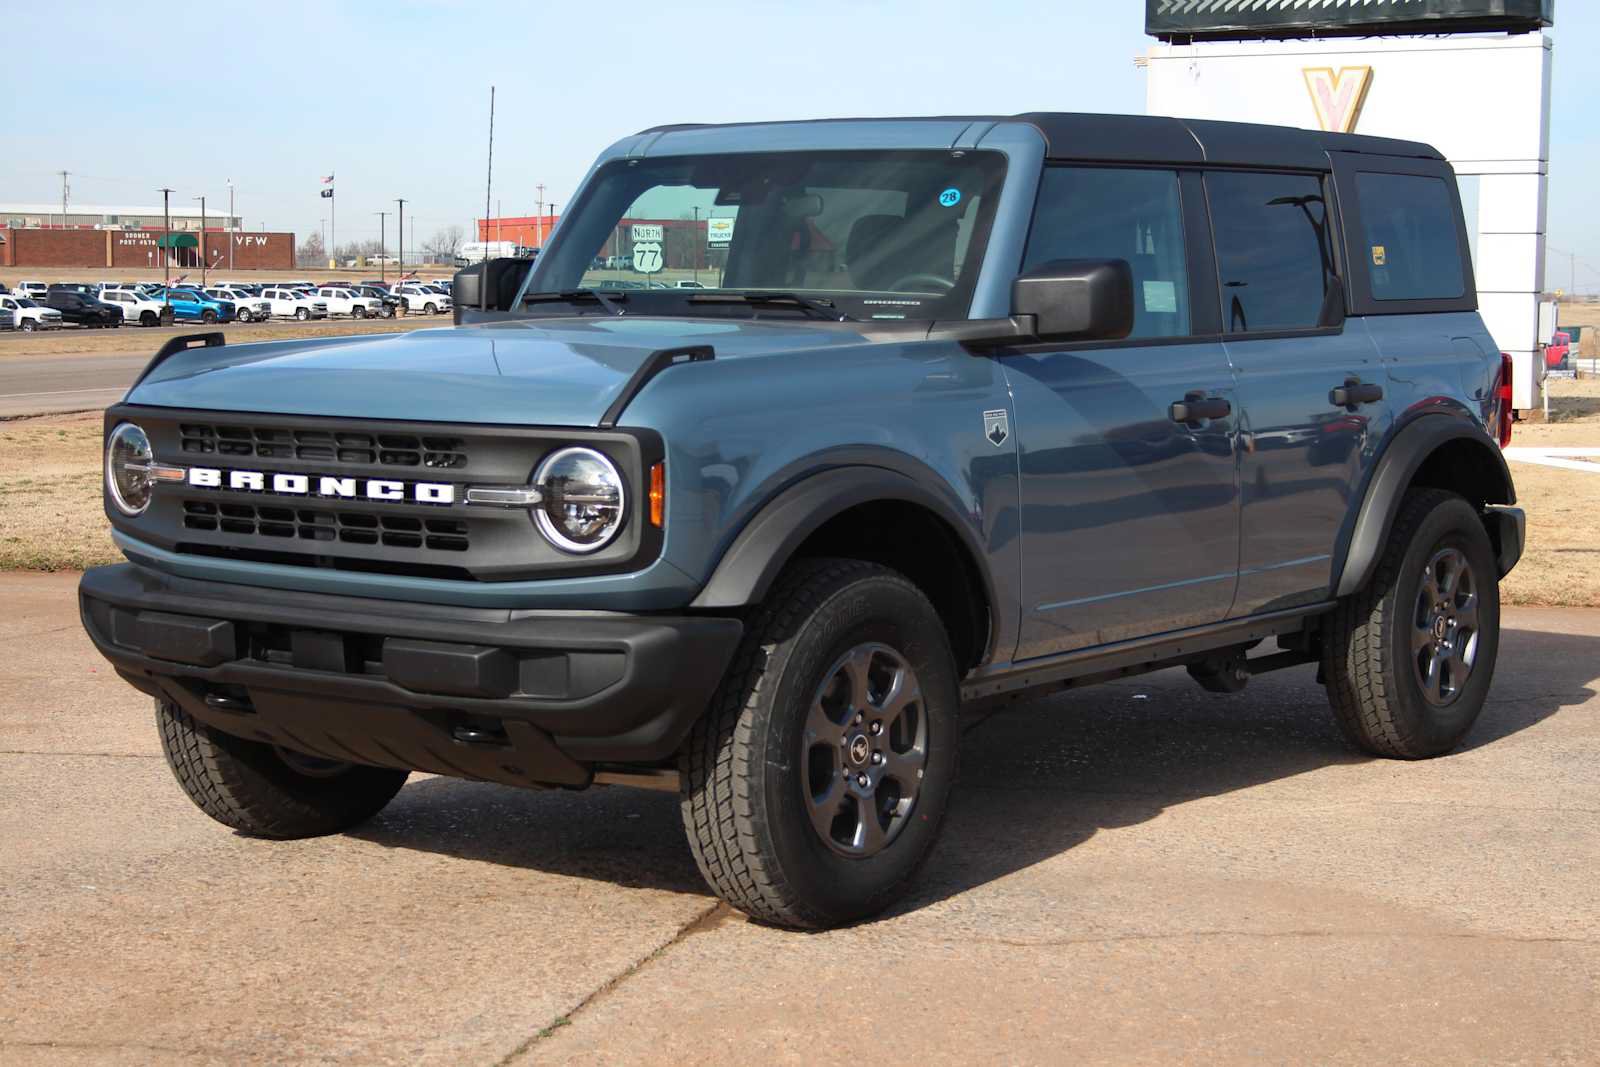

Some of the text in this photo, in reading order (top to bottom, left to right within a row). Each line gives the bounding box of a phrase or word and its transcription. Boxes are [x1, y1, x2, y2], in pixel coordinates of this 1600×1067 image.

[942, 191, 957, 204] 28
[634, 227, 661, 239] NORTH
[235, 236, 268, 246] VFW
[636, 250, 659, 267] 77
[189, 467, 455, 504] BRONCO
